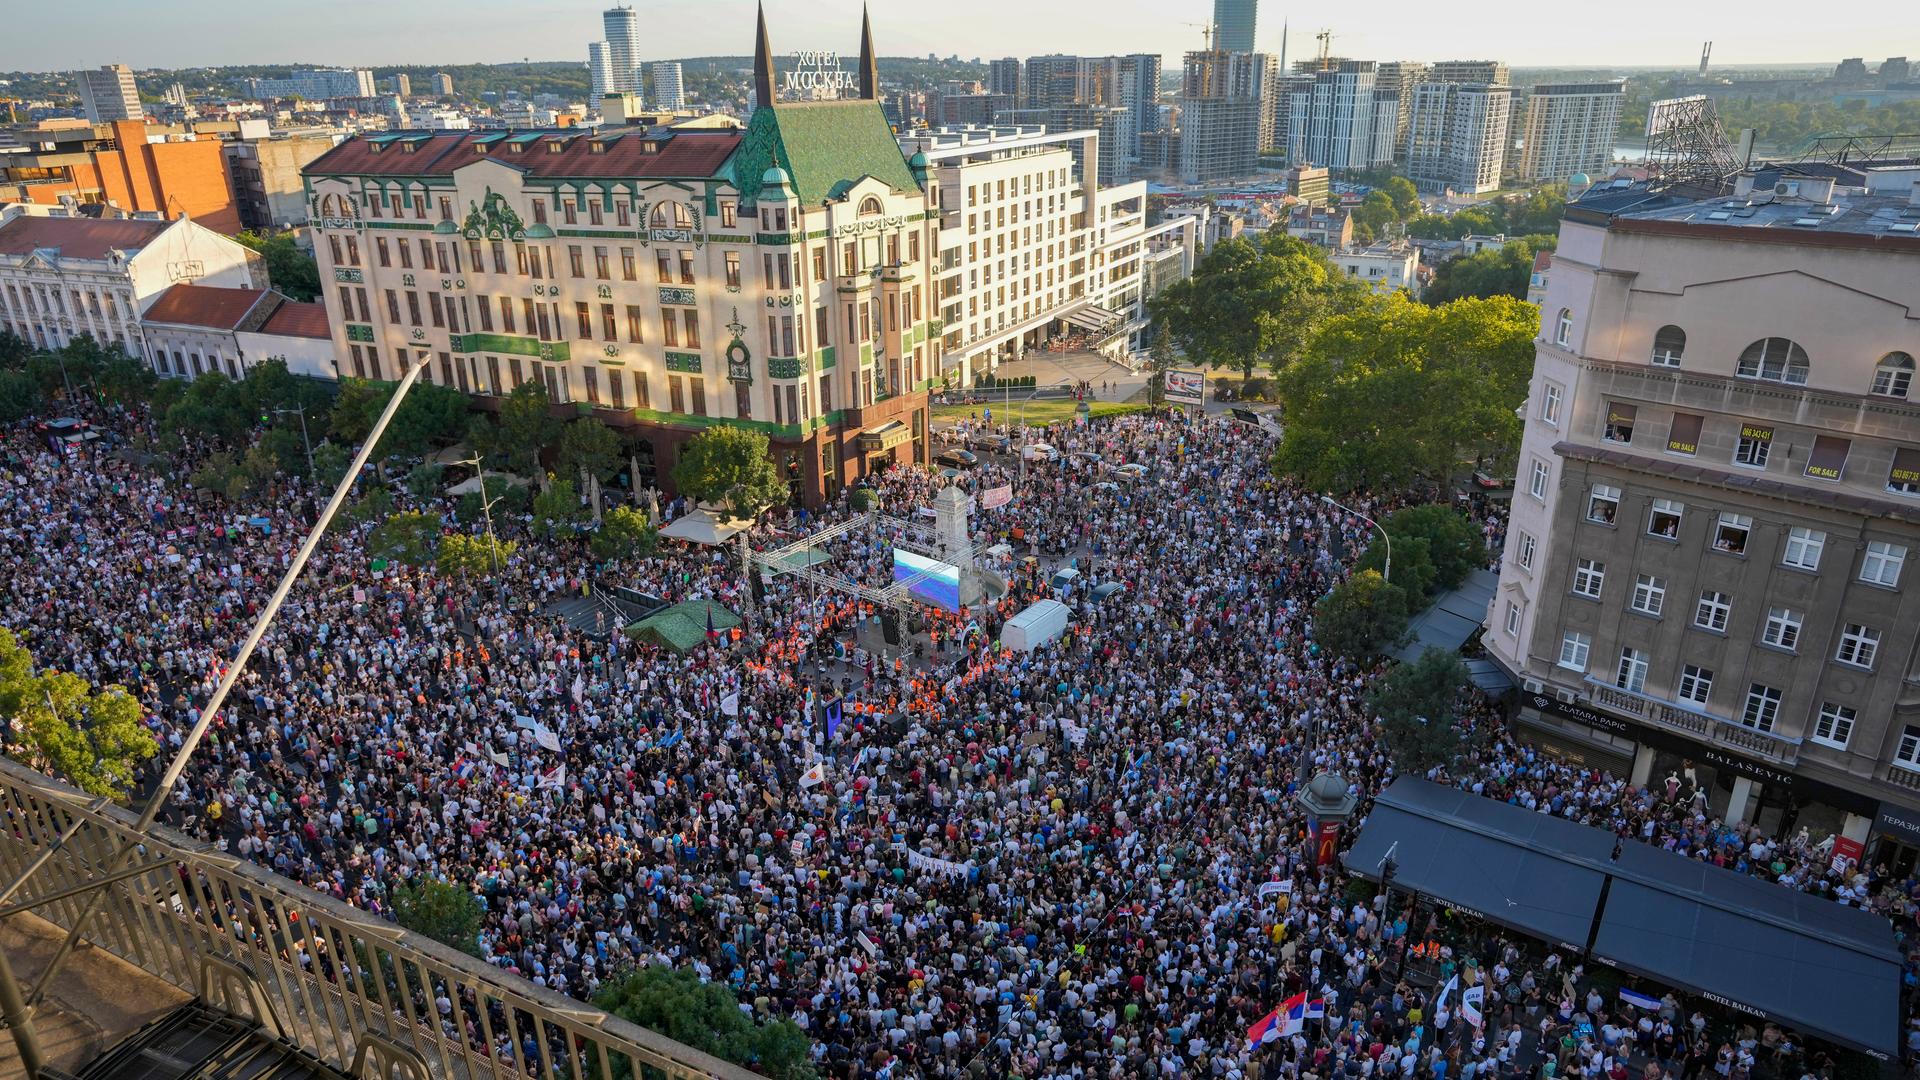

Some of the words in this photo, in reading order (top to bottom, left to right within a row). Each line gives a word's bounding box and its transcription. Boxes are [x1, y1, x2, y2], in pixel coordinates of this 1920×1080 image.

[796, 50, 841, 66] ХОТЕЛ
[785, 71, 854, 90] МОСКВА
[1669, 441, 1681, 450] FOR
[1681, 443, 1696, 453] SALE
[1808, 465, 1822, 475] FOR
[1822, 468, 1839, 478] SALE
[1558, 704, 1597, 721] ZLATARA
[1600, 717, 1627, 730] PAPIĆ
[1705, 751, 1793, 785] BALAŠEVIĆ
[1883, 814, 1920, 833] ТЕРАЗИ
[1434, 897, 1455, 911] HOTEL
[1456, 905, 1484, 919] BALKAN
[1703, 991, 1731, 1007] HOTEL
[1731, 1001, 1767, 1018] BALKAN
